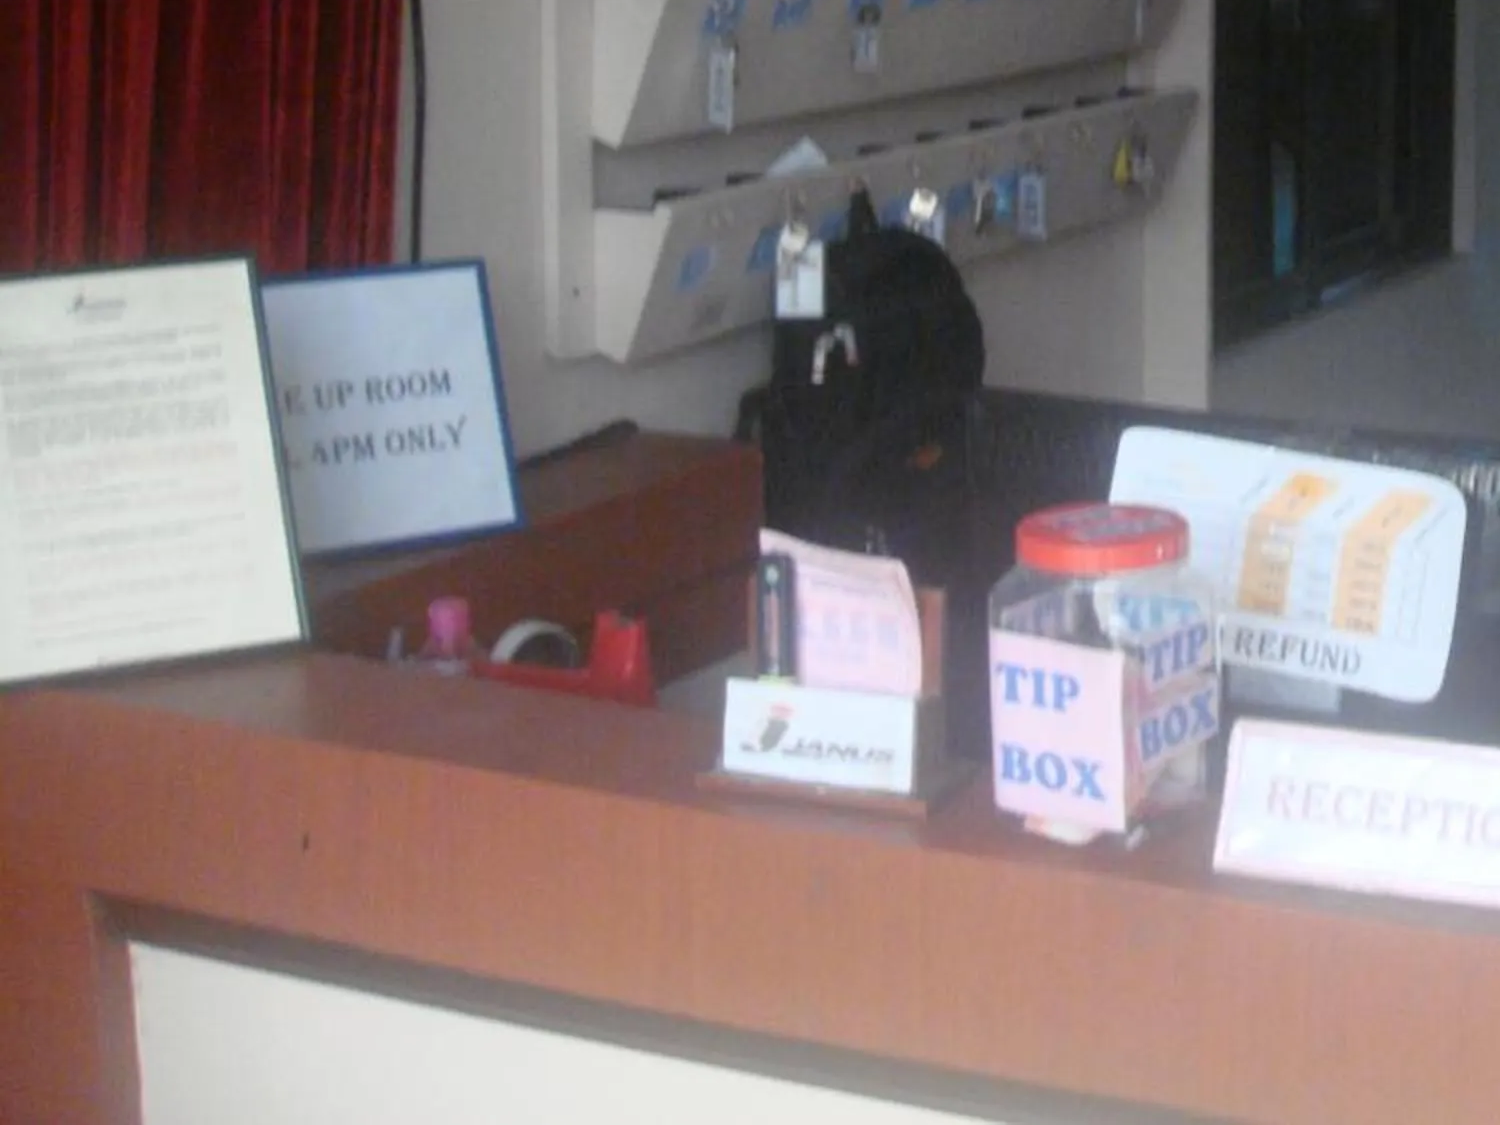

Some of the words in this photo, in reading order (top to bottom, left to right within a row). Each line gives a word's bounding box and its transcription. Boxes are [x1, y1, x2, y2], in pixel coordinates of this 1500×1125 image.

[312, 378, 354, 412] UP
[364, 368, 453, 405] ROOM
[384, 413, 468, 455] ONLY
[1144, 623, 1209, 681] TIP
[1233, 626, 1362, 677] REFUND
[996, 661, 1080, 713] TIP
[1140, 689, 1216, 762] BOX
[1000, 744, 1106, 802] BOX
